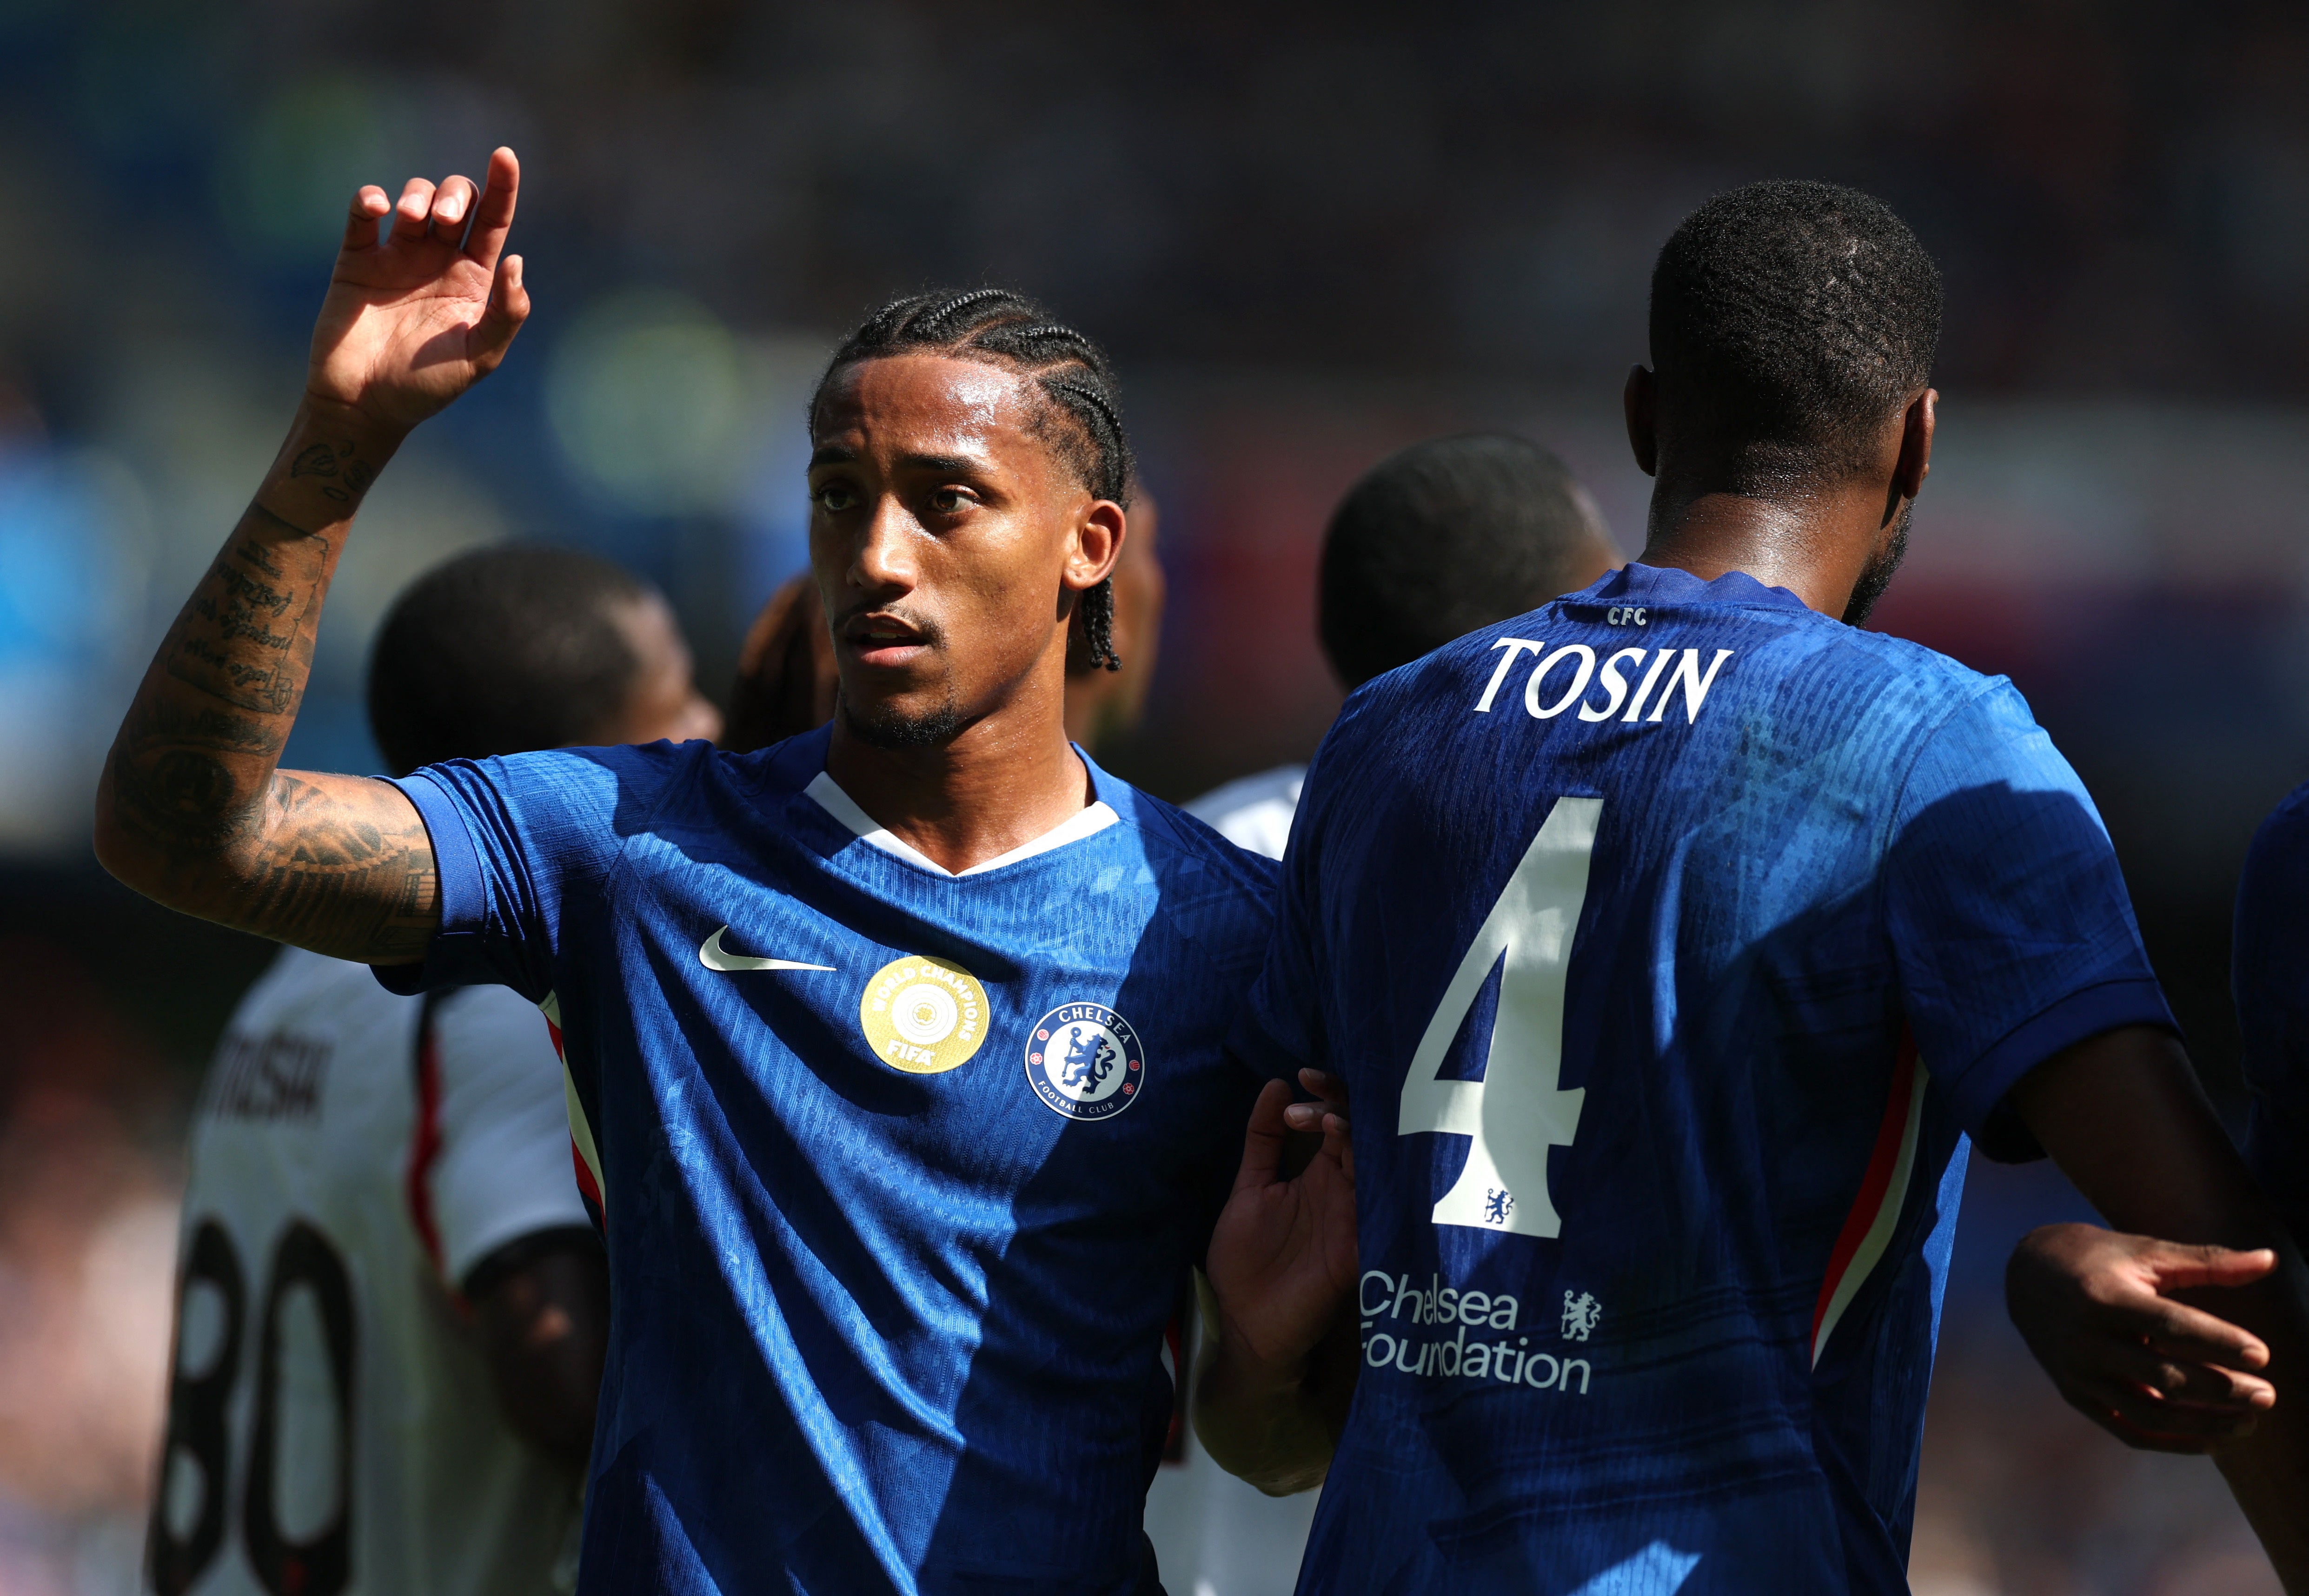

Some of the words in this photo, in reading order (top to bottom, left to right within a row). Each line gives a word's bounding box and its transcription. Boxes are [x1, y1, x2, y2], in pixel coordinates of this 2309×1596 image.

[1607, 607, 1646, 626] CFC
[1473, 637, 1735, 725] TOSIN
[872, 967, 916, 1011] WORLD
[920, 965, 978, 1042] CHAMPIONS
[1058, 1007, 1131, 1044] CHELSEA
[1398, 796, 1604, 1239] 4
[885, 1039, 932, 1066] FIFA
[1038, 1080, 1083, 1113] FOOTBALL
[1088, 1102, 1114, 1114] CLUB
[1359, 1270, 1519, 1331] Chelsea
[148, 1211, 357, 1596] 80
